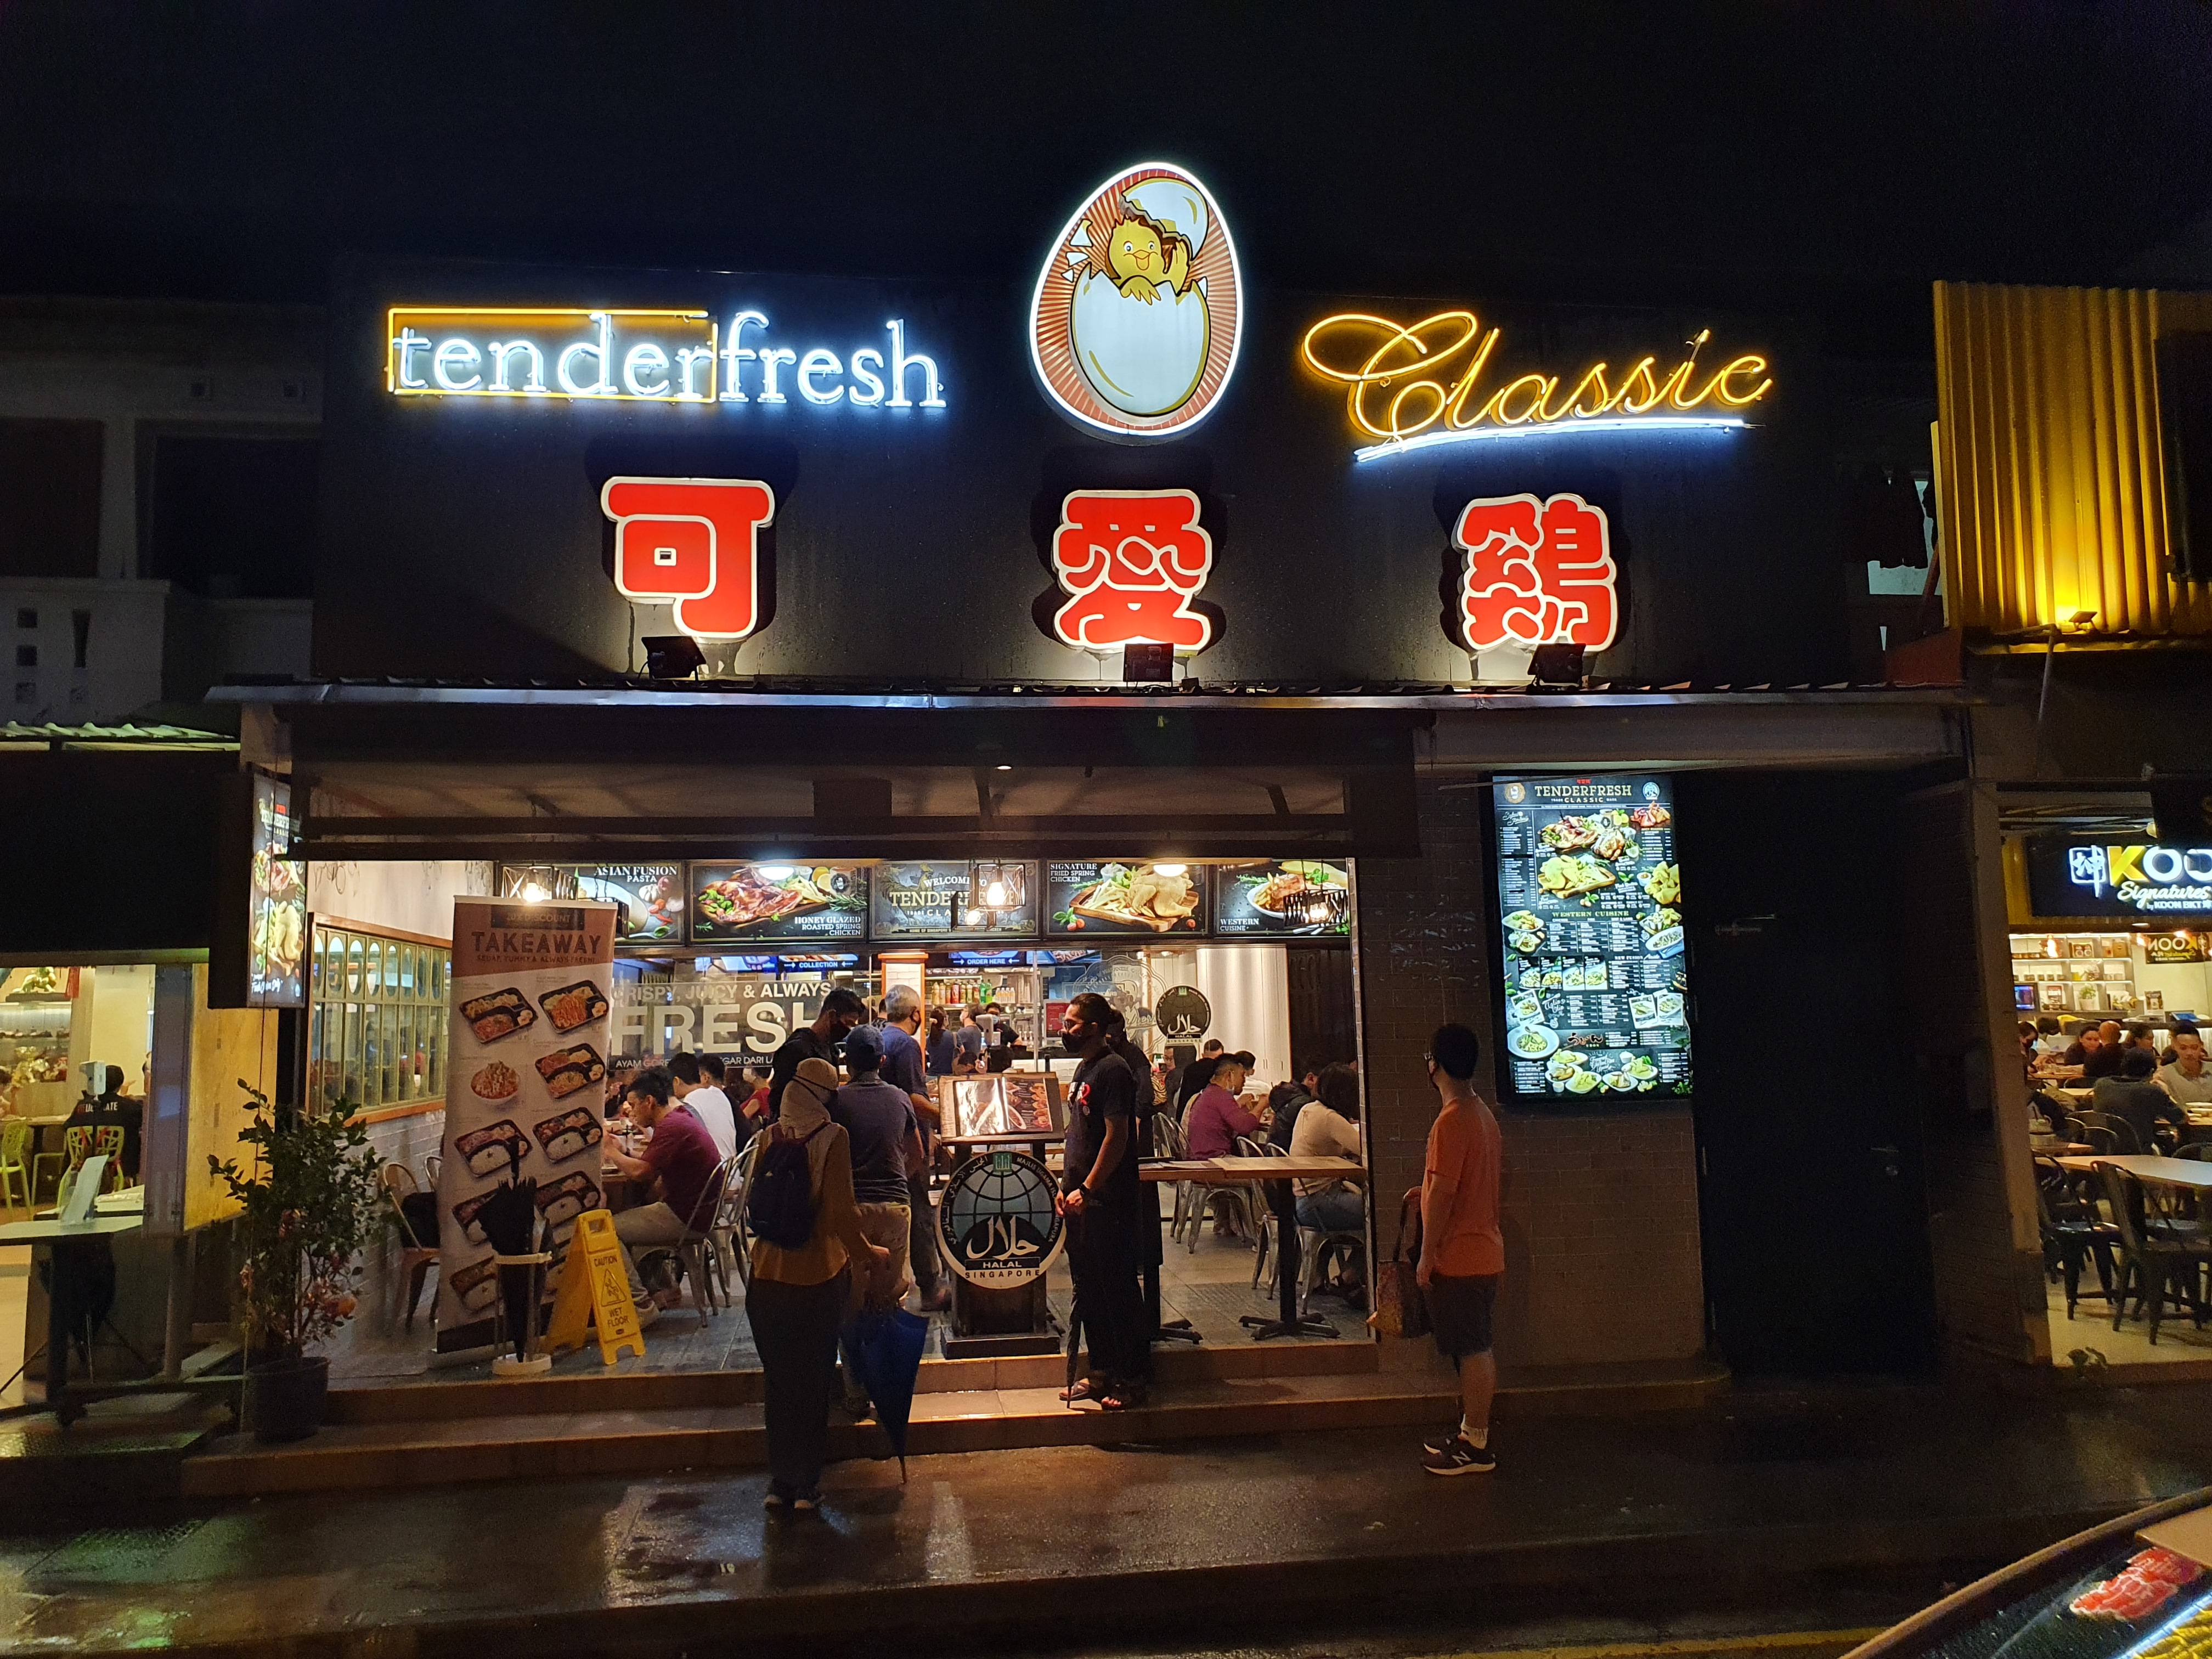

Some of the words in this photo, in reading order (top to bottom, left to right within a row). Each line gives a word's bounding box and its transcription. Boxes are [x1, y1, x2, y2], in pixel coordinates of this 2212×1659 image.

[392, 310, 947, 408] tenderfresh
[1302, 311, 1773, 440] Classic
[601, 476, 775, 640] 可
[1053, 489, 1212, 653] 愛
[1534, 785, 1632, 797] TENDERFRESH
[595, 866, 630, 876] ASIAN
[633, 866, 678, 876] FUSION
[2118, 881, 2211, 909] Signatures
[471, 931, 601, 954] TAKEAWAY
[685, 984, 737, 999] JUICY
[743, 984, 755, 998] &
[760, 983, 832, 998] ALWAYS
[1167, 1013, 1201, 1035] حلال
[1567, 1032, 1603, 1046] うどん
[616, 1059, 642, 1068] AYAM
[642, 1058, 669, 1068] GORE
[720, 1057, 742, 1065] GAR
[743, 1056, 764, 1065] DARI
[1017, 1156, 1037, 1171] MAJLIS
[966, 1215, 1040, 1261] حلال
[594, 1255, 618, 1267] CAUTION
[983, 1261, 1022, 1269] HALAL
[965, 1269, 1040, 1278] SINGAPORE
[609, 1306, 623, 1317] WET
[607, 1316, 629, 1327] FLOOR
